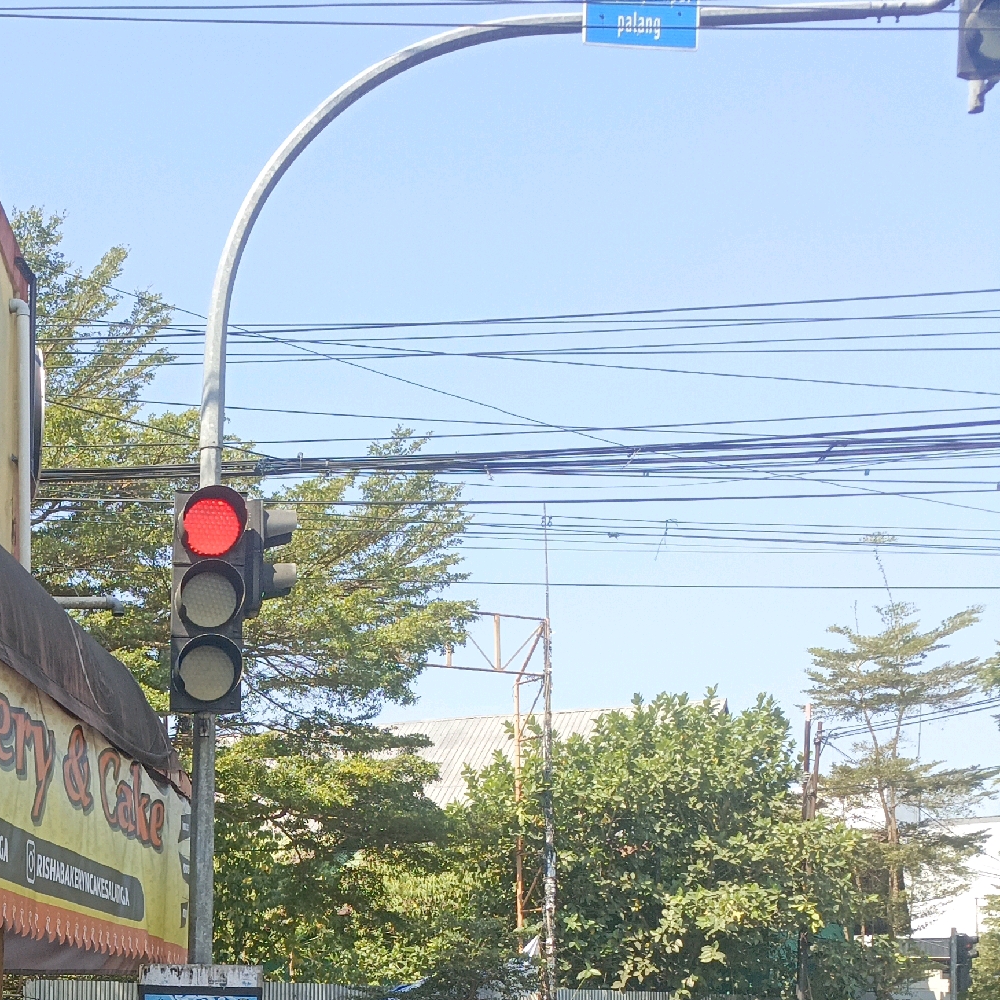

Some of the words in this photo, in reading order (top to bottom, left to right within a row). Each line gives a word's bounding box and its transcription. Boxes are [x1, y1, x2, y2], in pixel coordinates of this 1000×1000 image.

[617, 11, 661, 41] palang
[63, 724, 93, 812] &
[99, 747, 164, 852] Cake
